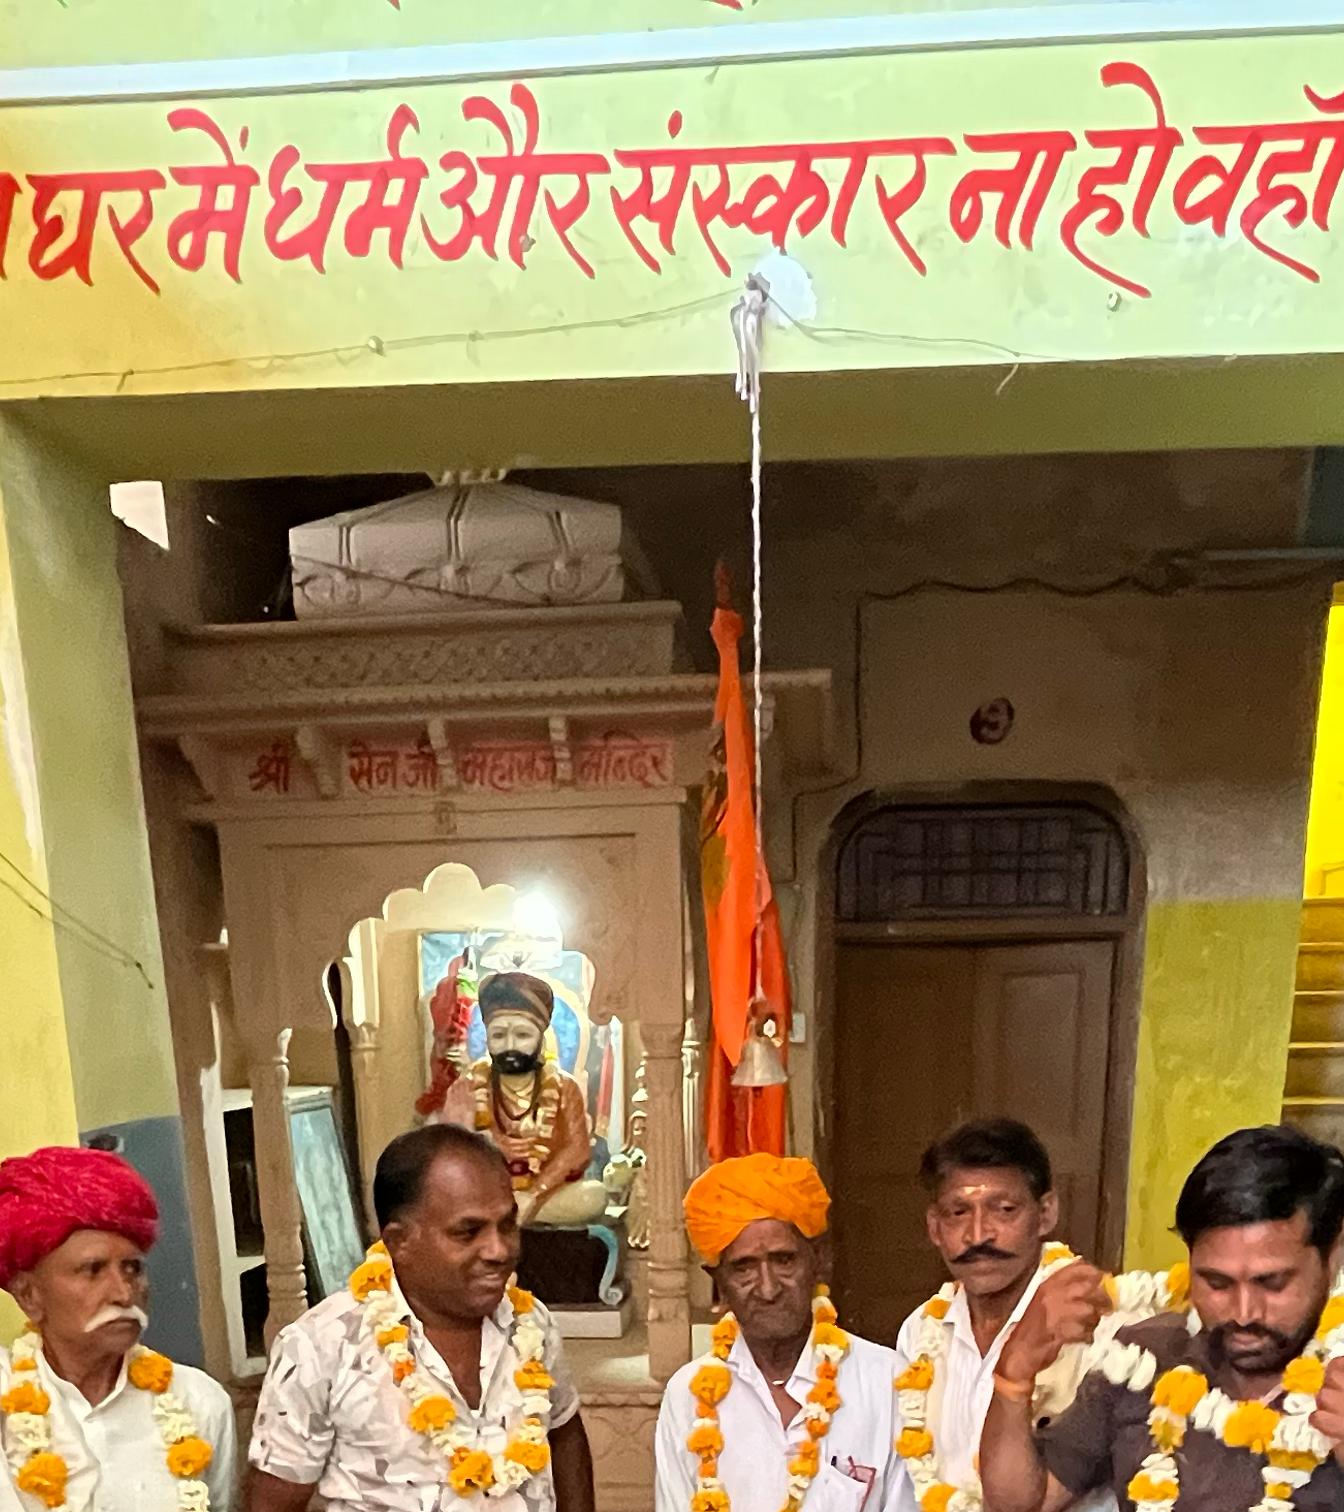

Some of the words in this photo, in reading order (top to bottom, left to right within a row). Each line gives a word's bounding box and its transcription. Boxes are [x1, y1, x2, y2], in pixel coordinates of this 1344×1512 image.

[26, 169, 162, 296] घर
[166, 108, 261, 284] में
[264, 103, 434, 275] धर्म
[420, 83, 612, 280] और
[609, 111, 958, 278] संस्कार
[948, 130, 1077, 251] ना
[1059, 61, 1184, 299] हो
[248, 741, 290, 795] श्री
